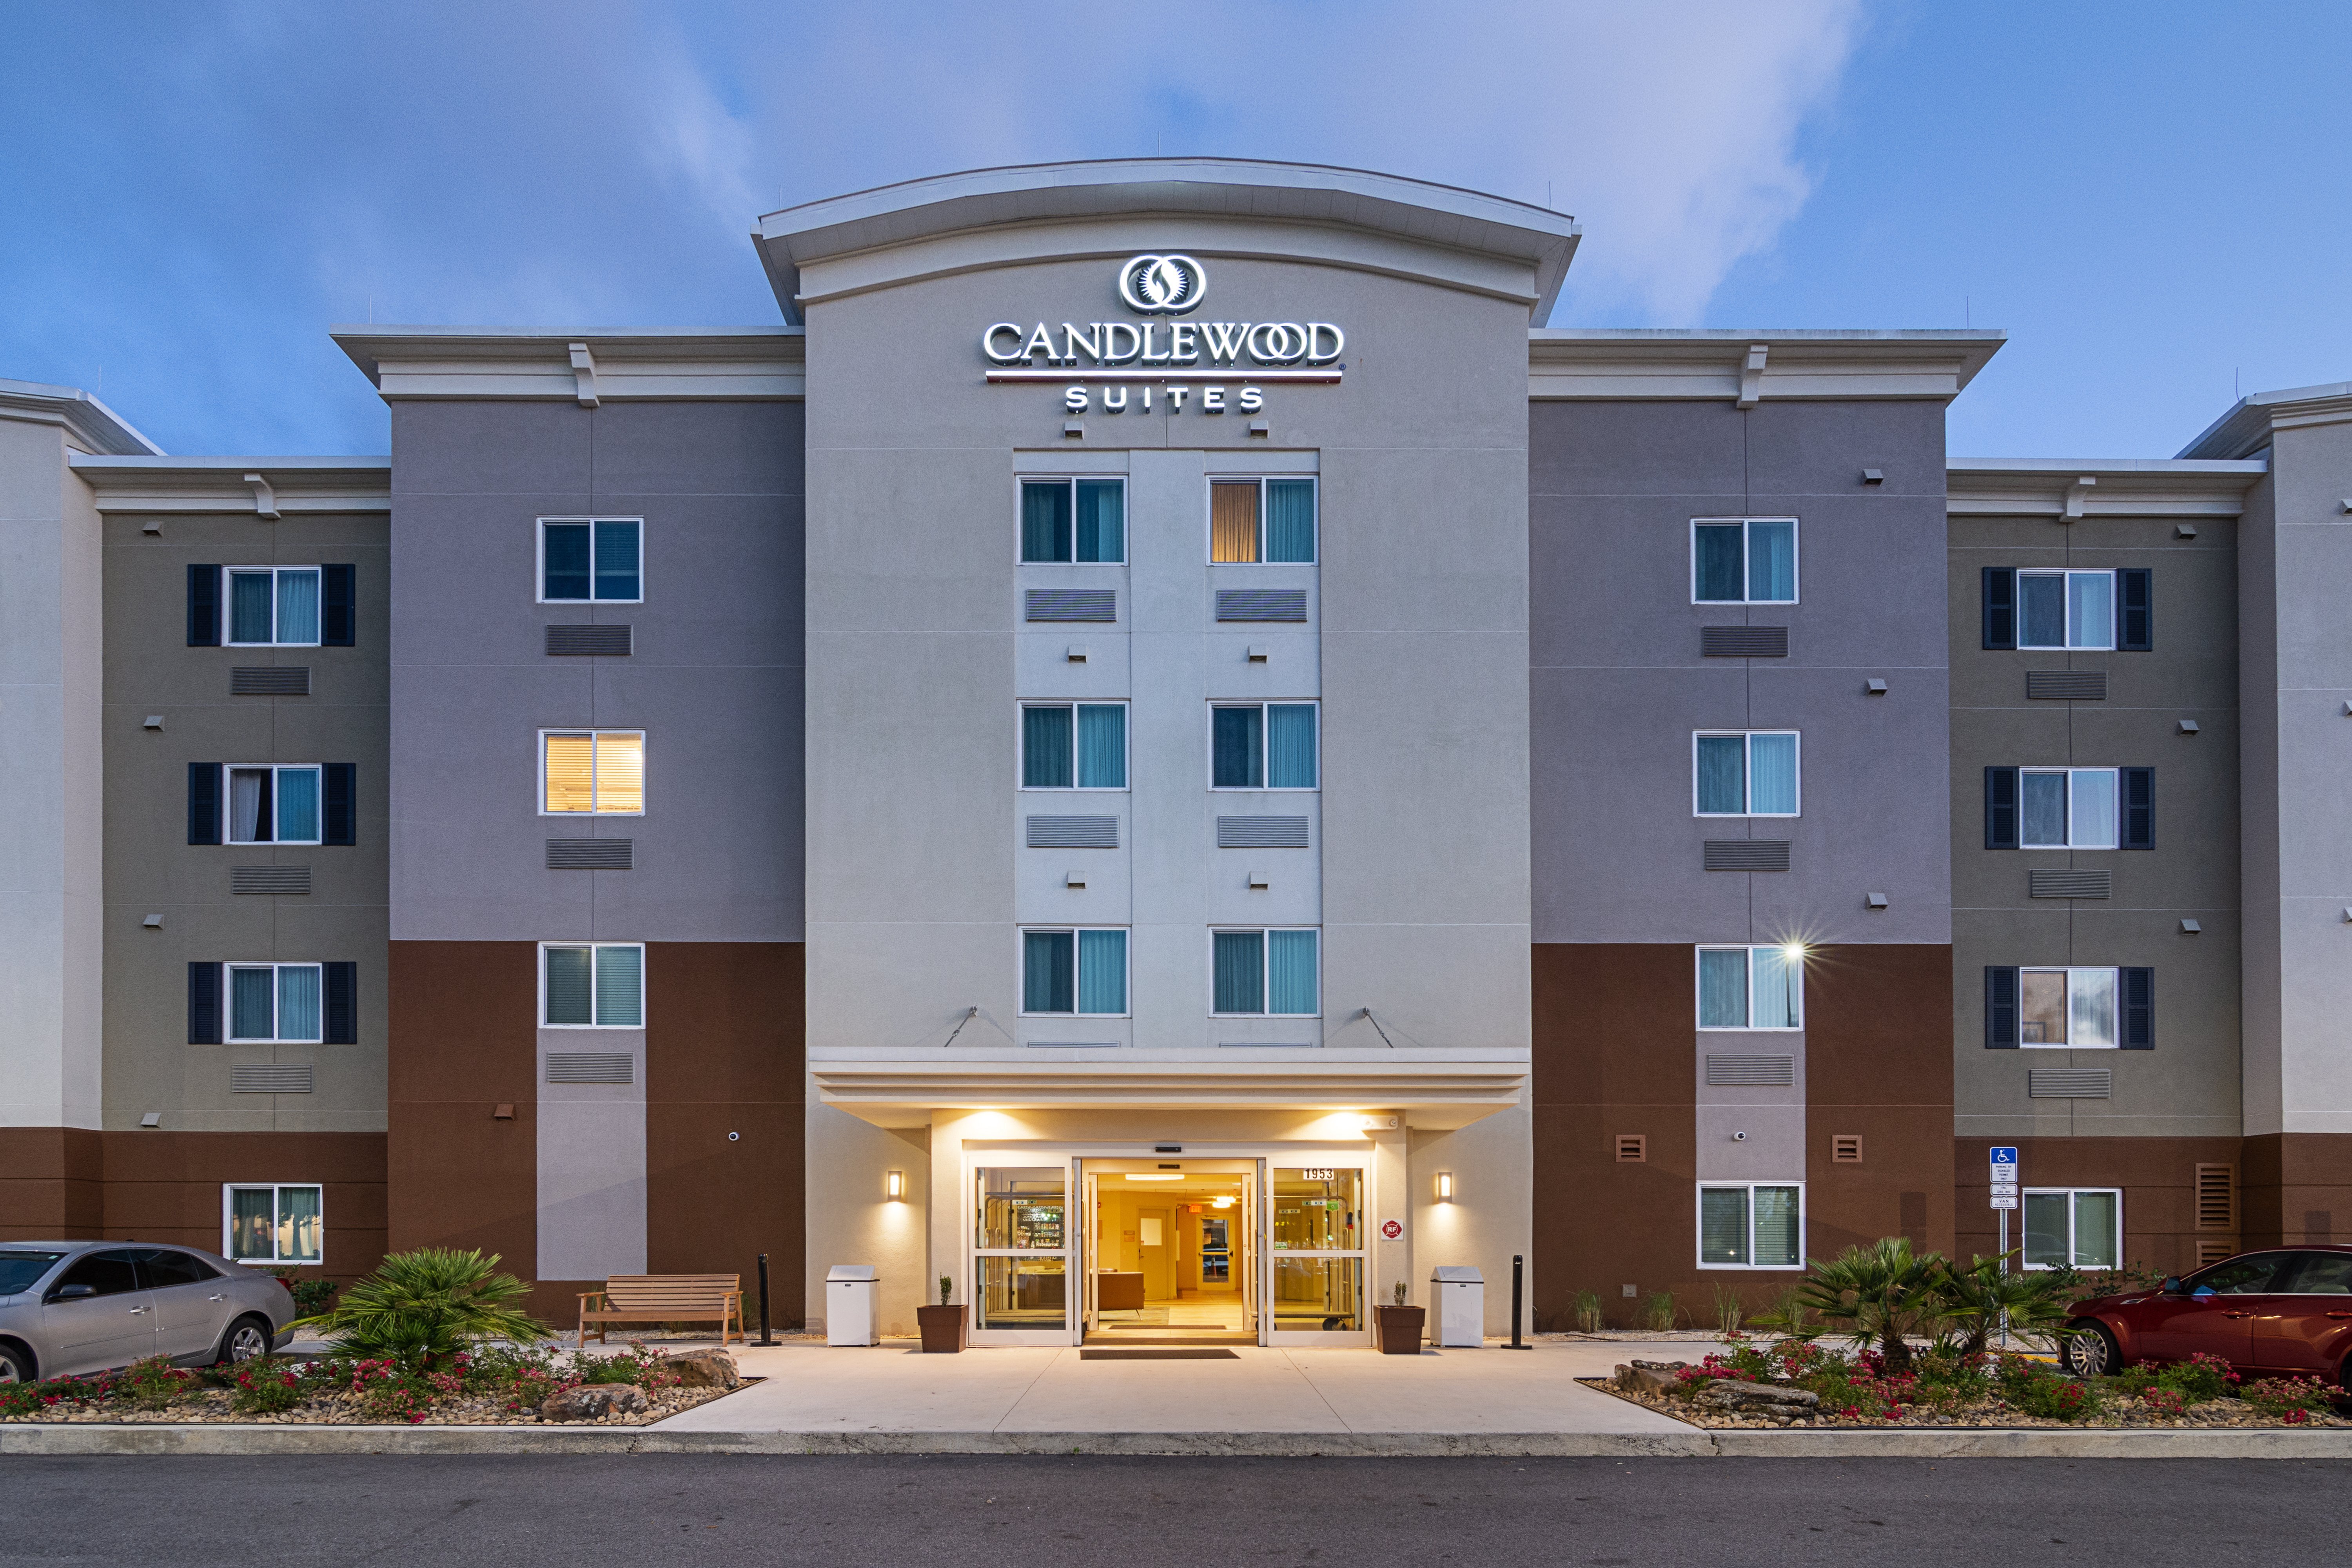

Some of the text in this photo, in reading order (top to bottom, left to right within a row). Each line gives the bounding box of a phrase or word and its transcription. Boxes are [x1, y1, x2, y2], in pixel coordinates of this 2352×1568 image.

[984, 322, 1344, 362] CANDLEWOOD
[1065, 387, 1263, 408] SUITES
[1305, 1169, 1332, 1179] 1953
